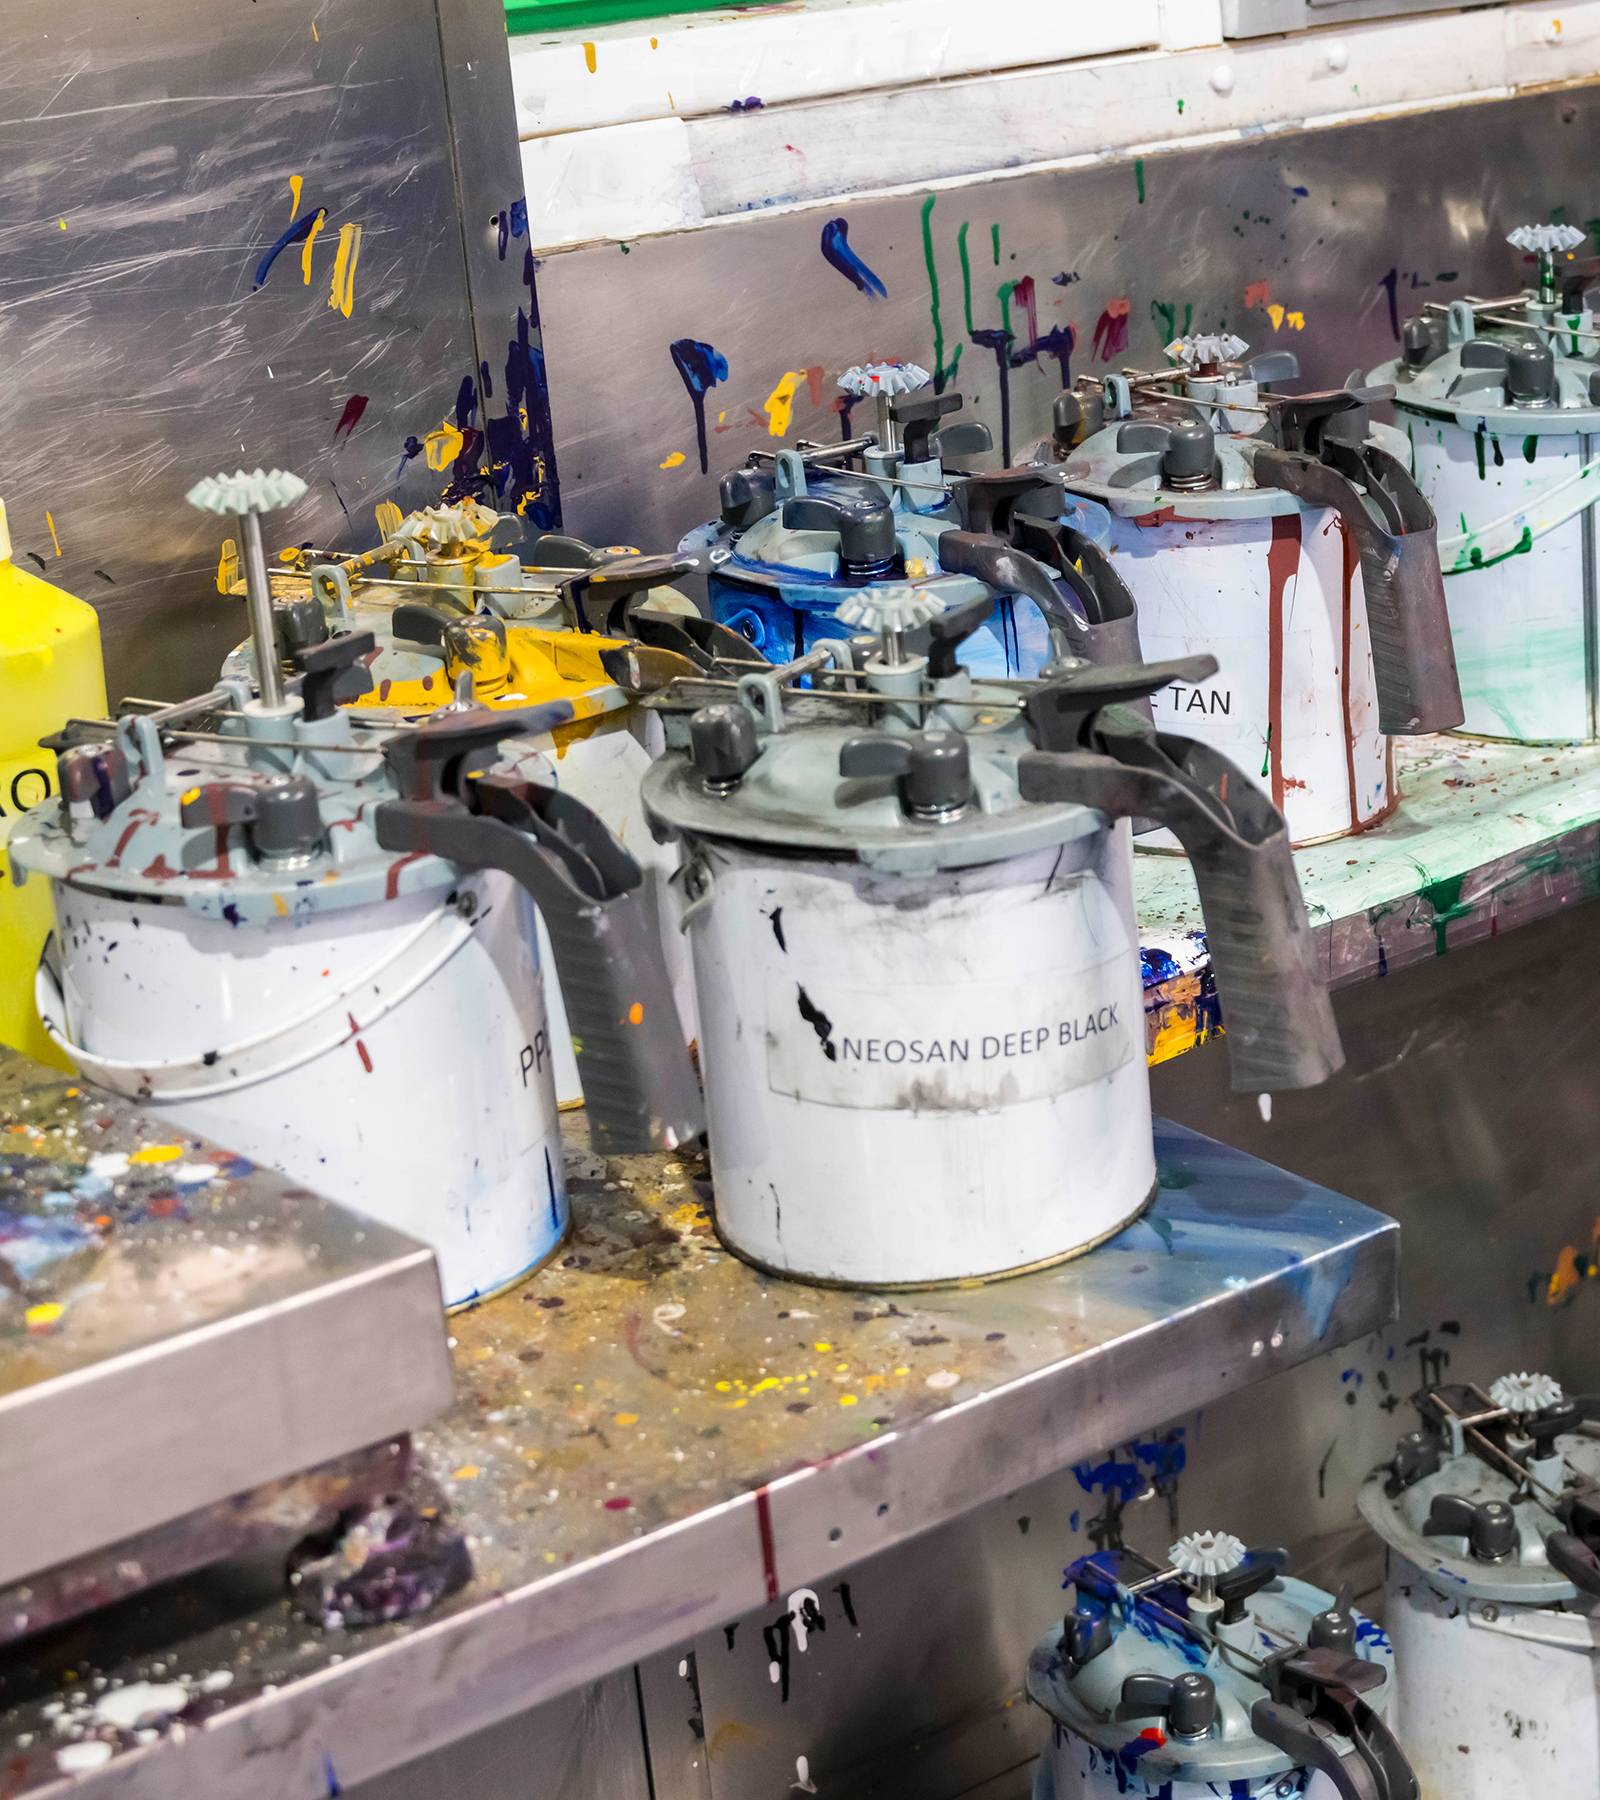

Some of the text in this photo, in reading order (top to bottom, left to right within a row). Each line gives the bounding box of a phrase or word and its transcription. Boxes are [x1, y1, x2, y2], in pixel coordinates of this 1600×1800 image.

[1168, 686, 1231, 715] TAN
[0, 768, 51, 817] O
[843, 1002, 1119, 1063] NEOSAN DEEP BLACK
